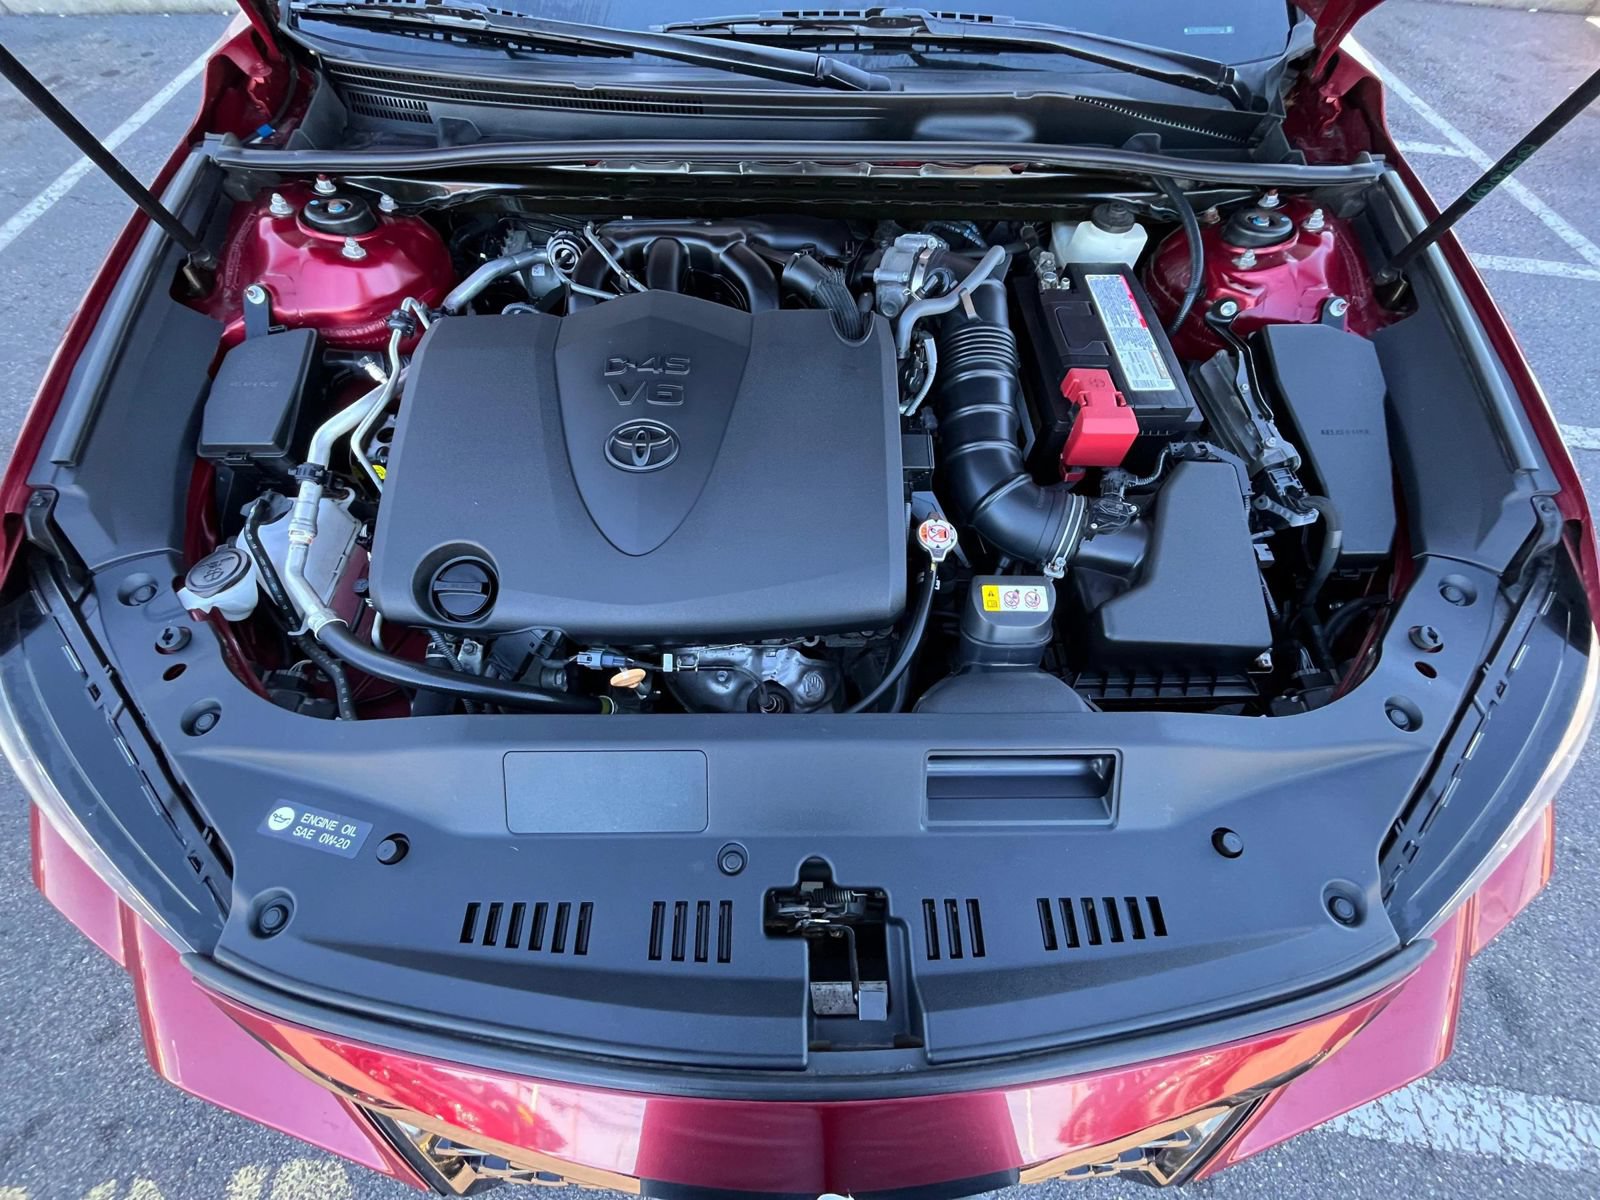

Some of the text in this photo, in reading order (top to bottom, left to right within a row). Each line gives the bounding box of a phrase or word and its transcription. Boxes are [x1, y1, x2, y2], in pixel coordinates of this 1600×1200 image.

[607, 381, 684, 406] V6
[300, 813, 357, 837] ENGINE OIL
[293, 826, 351, 849] SAE 0W-20
